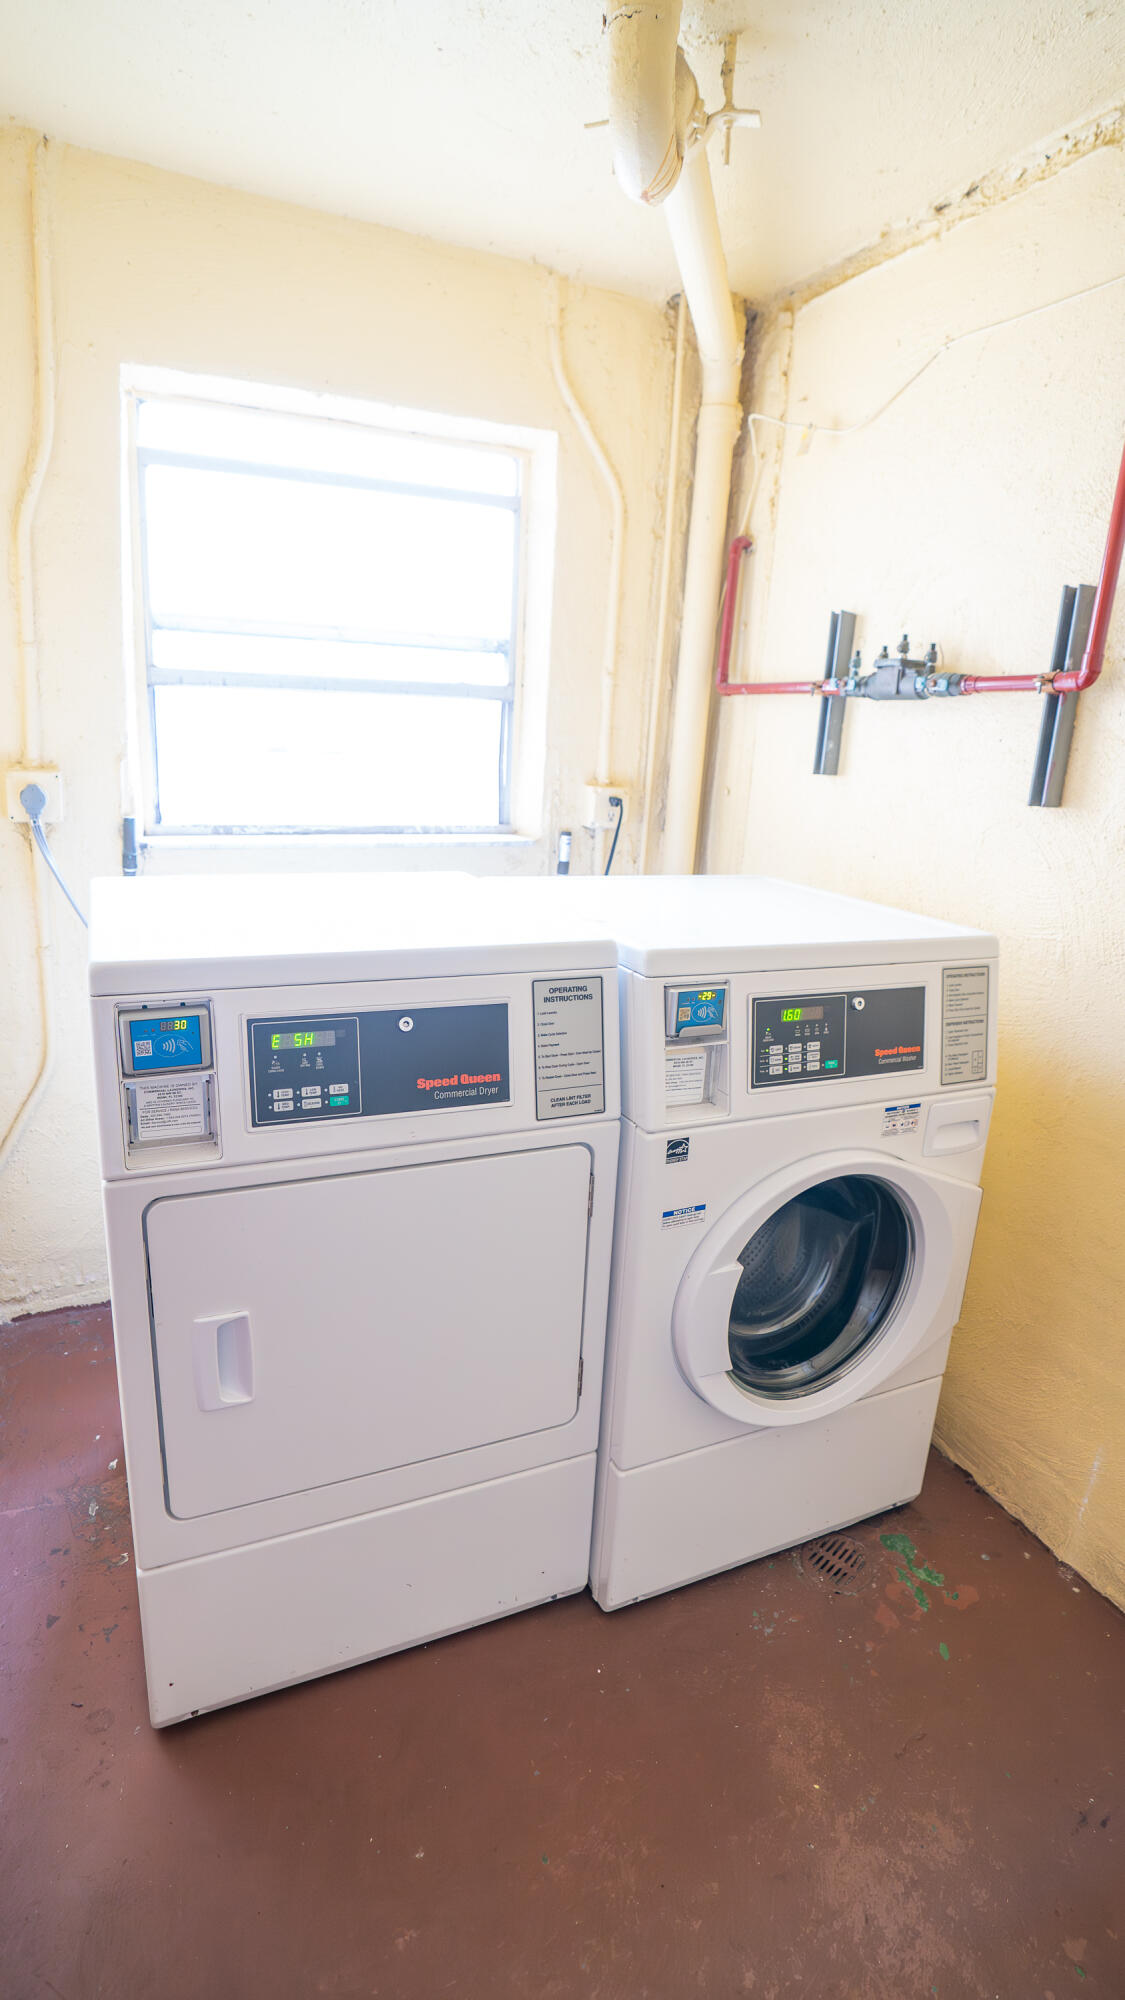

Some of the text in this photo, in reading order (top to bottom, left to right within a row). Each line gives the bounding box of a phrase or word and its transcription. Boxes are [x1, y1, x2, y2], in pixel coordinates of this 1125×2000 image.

[549, 985, 588, 994] OPERATING
[543, 993, 593, 1003] INSTRUCTIONS
[271, 1034, 280, 1048] E
[875, 1046, 897, 1058] Speed
[416, 1073, 501, 1090] Speed Queen
[434, 1087, 499, 1099] Commercial Dryer
[673, 1207, 696, 1216] NOTICE
